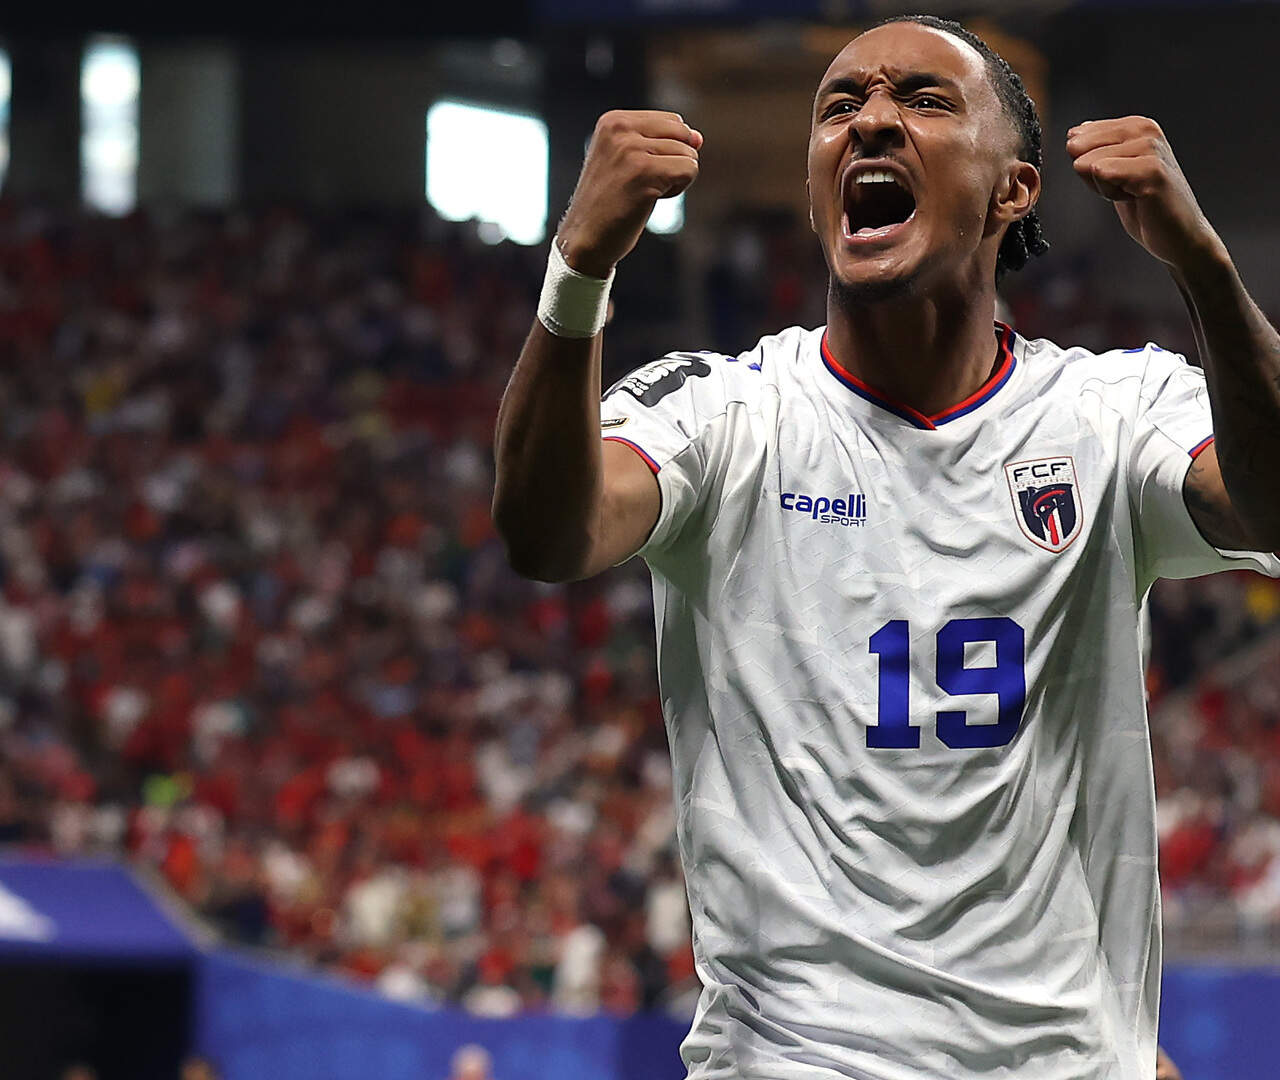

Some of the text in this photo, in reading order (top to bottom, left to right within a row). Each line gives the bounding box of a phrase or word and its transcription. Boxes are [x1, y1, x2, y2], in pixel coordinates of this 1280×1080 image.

[1014, 462, 1068, 483] FCF
[780, 493, 866, 520] capelli
[820, 514, 867, 528] SPORT
[866, 616, 1027, 750] 19
